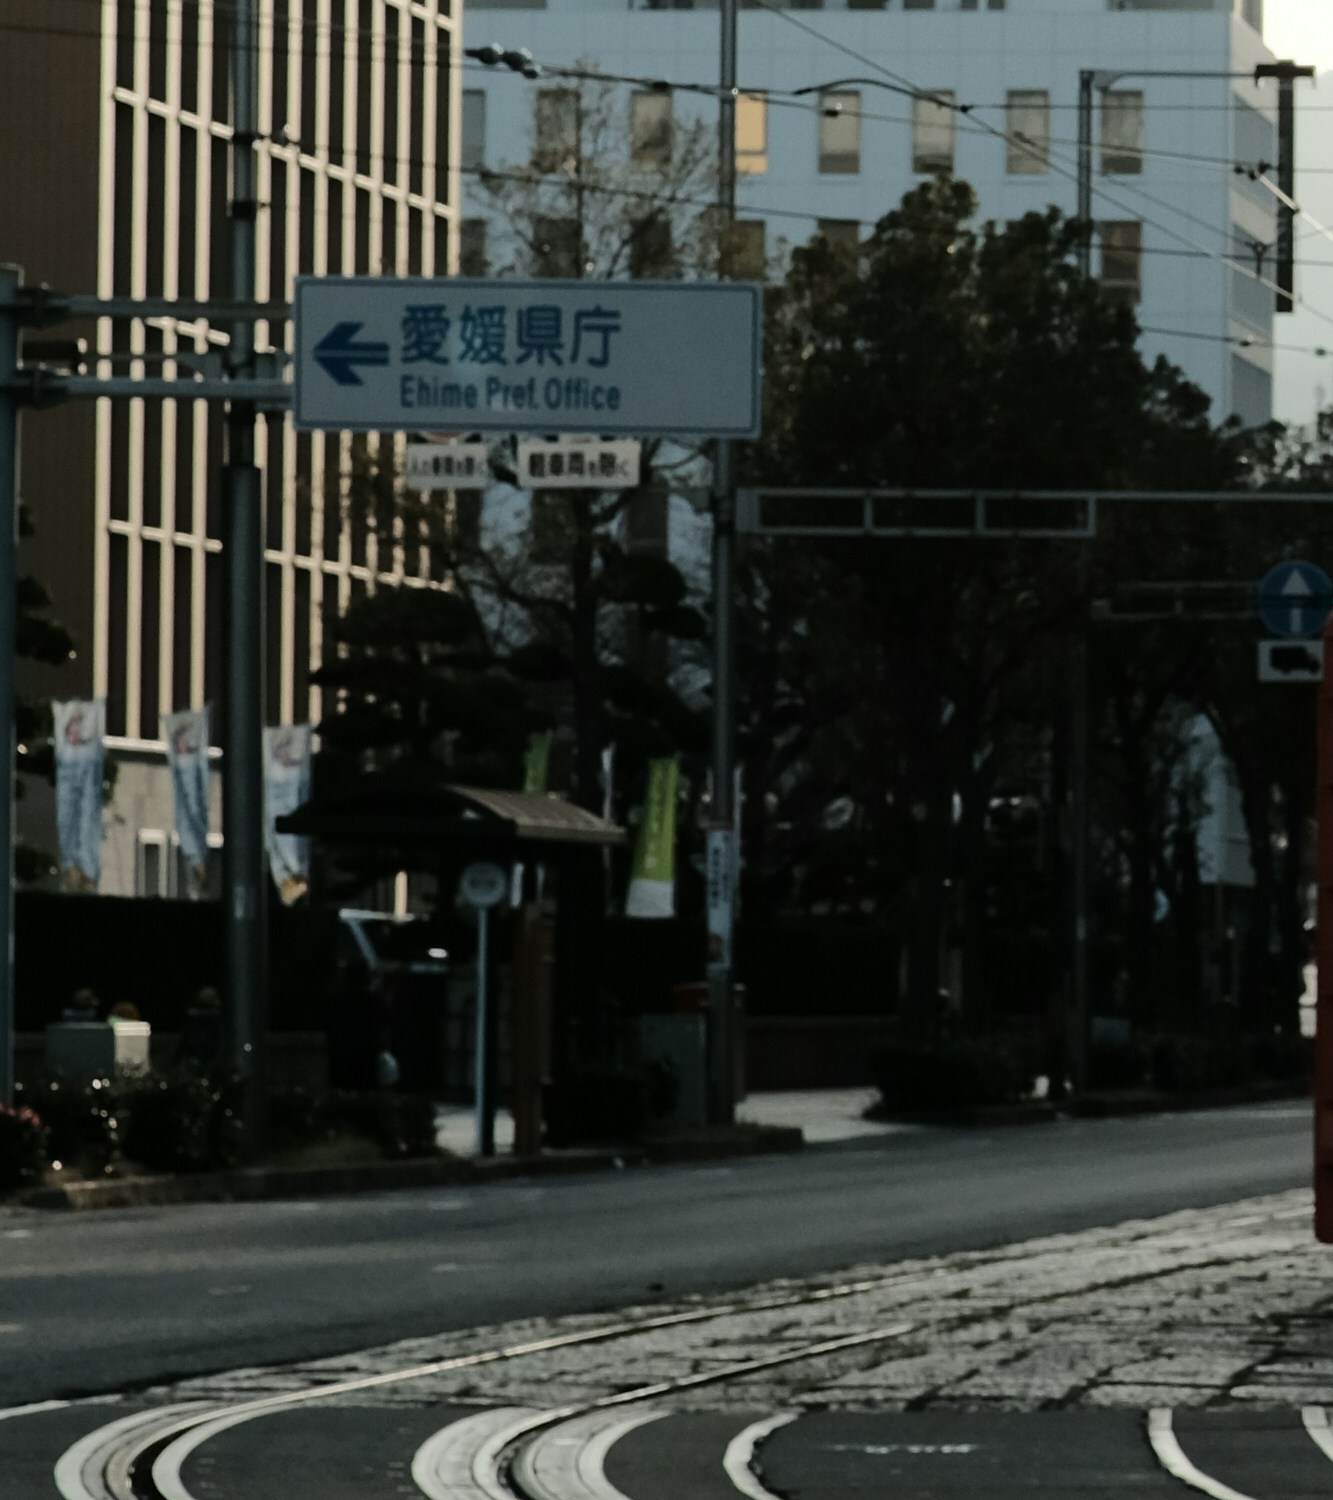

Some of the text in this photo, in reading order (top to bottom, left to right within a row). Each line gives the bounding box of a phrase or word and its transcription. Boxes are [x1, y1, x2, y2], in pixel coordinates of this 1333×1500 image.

[401, 304, 621, 367] 愛媛県庁
[401, 374, 478, 409] Ehime
[545, 377, 621, 411] Office
